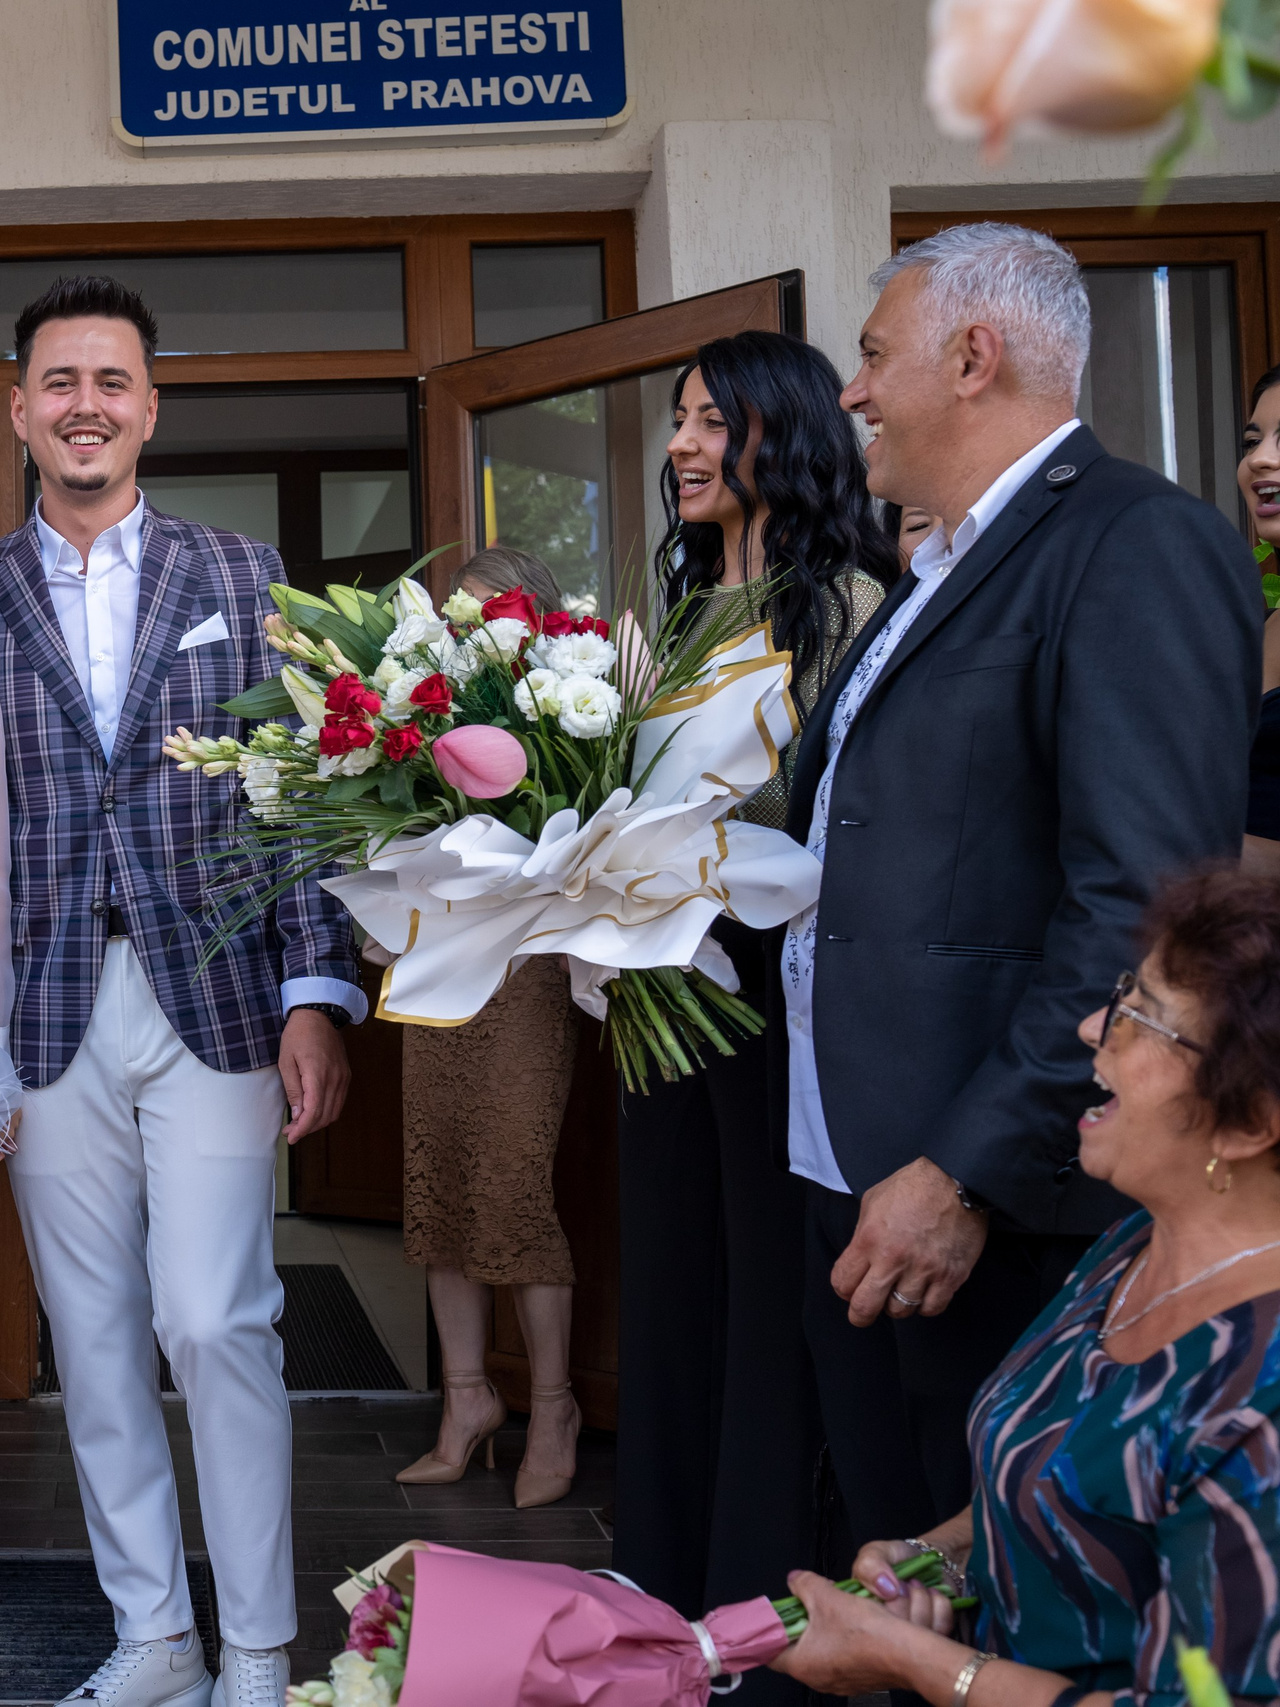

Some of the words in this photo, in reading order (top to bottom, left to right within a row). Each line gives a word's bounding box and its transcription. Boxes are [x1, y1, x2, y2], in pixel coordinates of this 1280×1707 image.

[154, 22, 361, 71] COMUNEI
[377, 12, 589, 60] STEFESTI
[153, 84, 356, 121] JUDETUL
[383, 74, 593, 110] PRAHOVA
